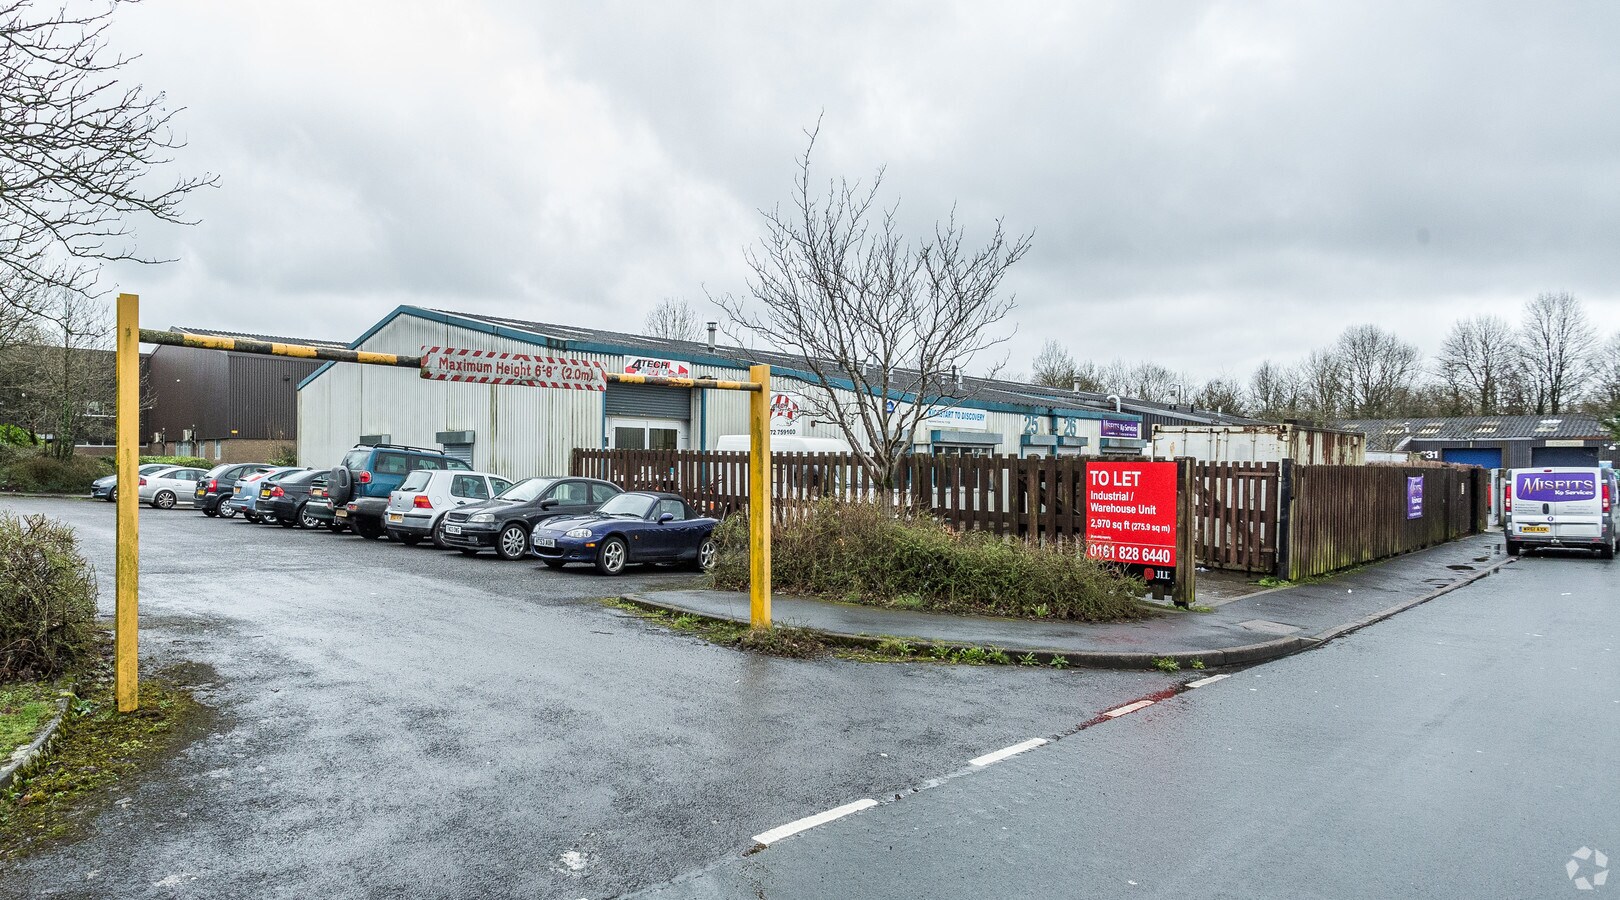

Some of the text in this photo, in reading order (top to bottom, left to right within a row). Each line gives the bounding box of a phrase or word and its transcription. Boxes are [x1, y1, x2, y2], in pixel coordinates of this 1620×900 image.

[438, 357, 493, 373] Maximum
[496, 363, 531, 377] Height
[561, 365, 594, 381] (2.0m)
[955, 411, 961, 420] TO
[961, 412, 985, 421] DISCOVERY
[1024, 414, 1039, 434] 25
[1063, 416, 1077, 436] 26
[1089, 470, 1141, 487] TO LET
[1520, 477, 1594, 497] MISFITS
[1090, 490, 1134, 501] Industrial /
[1090, 502, 1157, 515] Warehouse Unit
[1090, 518, 1171, 533] 2,970 sq ft (275.9 sq m)
[1089, 543, 1171, 563] 0161 828 6440
[1155, 570, 1171, 580] JLL
